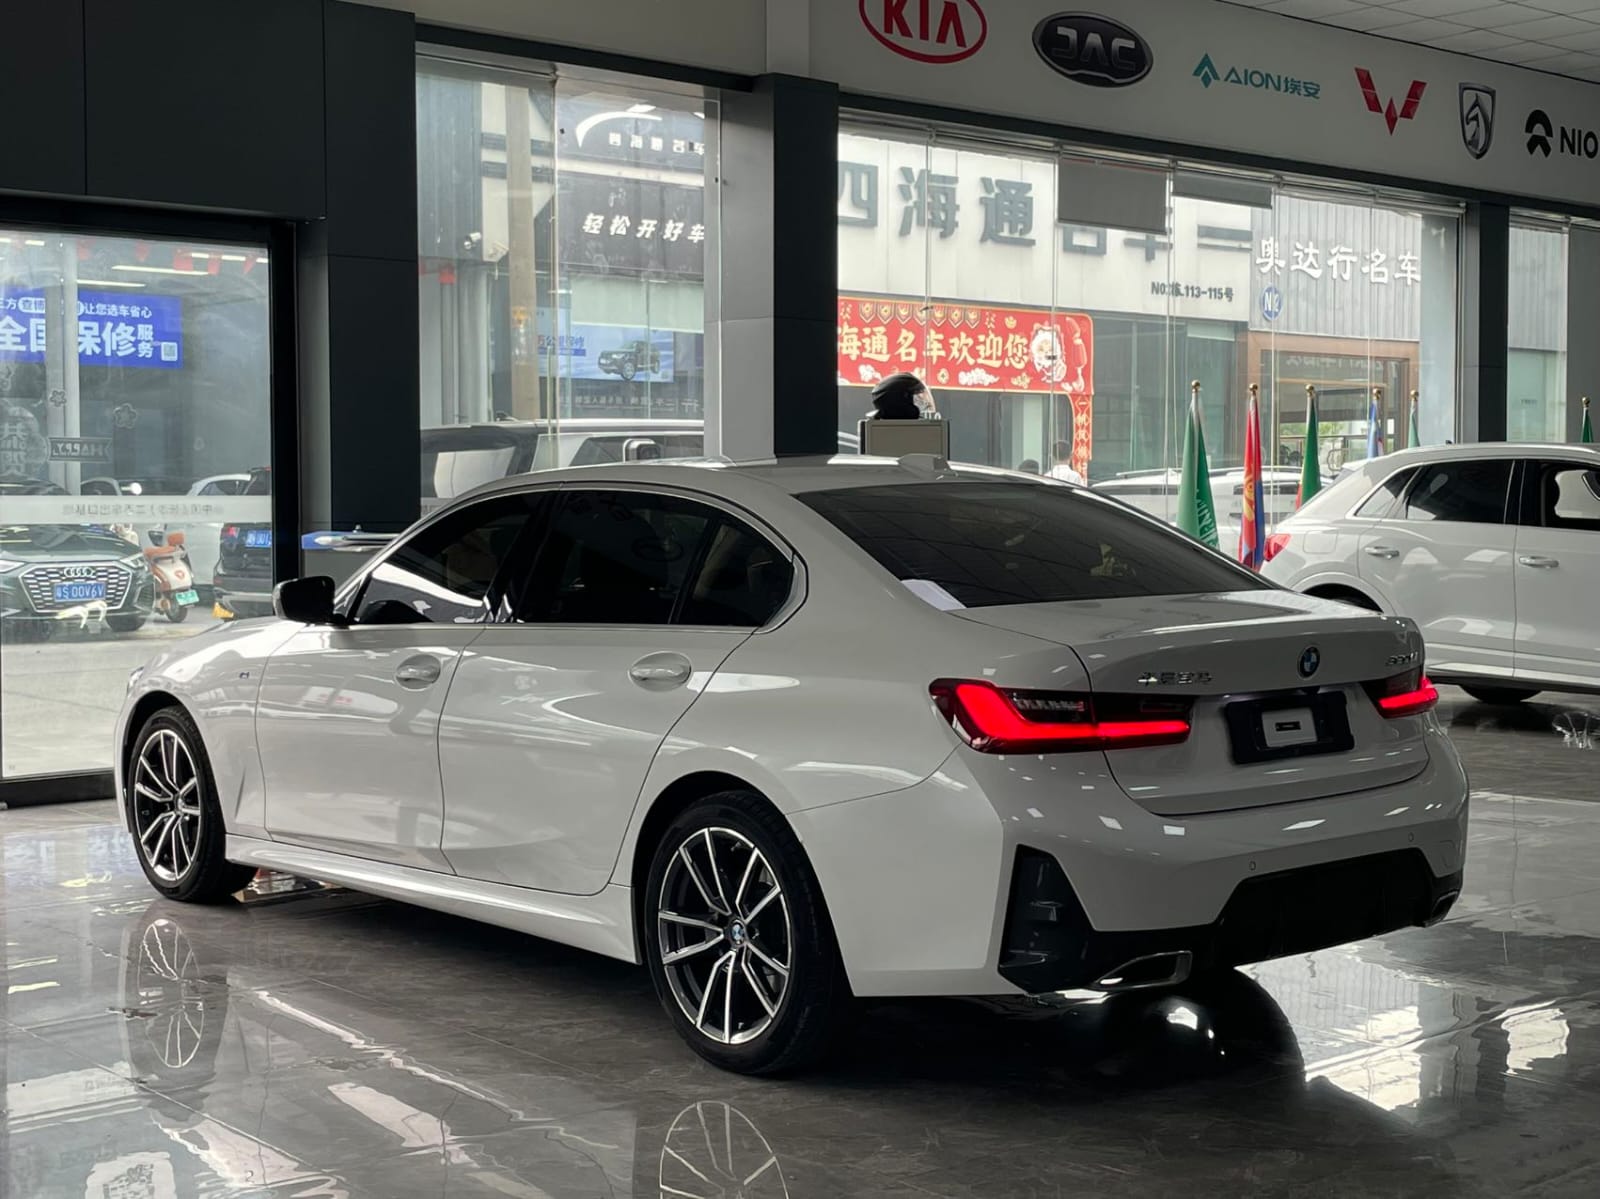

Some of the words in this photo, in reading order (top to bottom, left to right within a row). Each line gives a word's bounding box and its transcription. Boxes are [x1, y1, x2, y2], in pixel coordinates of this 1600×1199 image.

[883, 0, 967, 49] KIA
[1051, 26, 1136, 72] JAC
[1560, 126, 1599, 159] NIO
[582, 212, 705, 243] 轻松开好车
[1255, 236, 1422, 286] 奥达行名车
